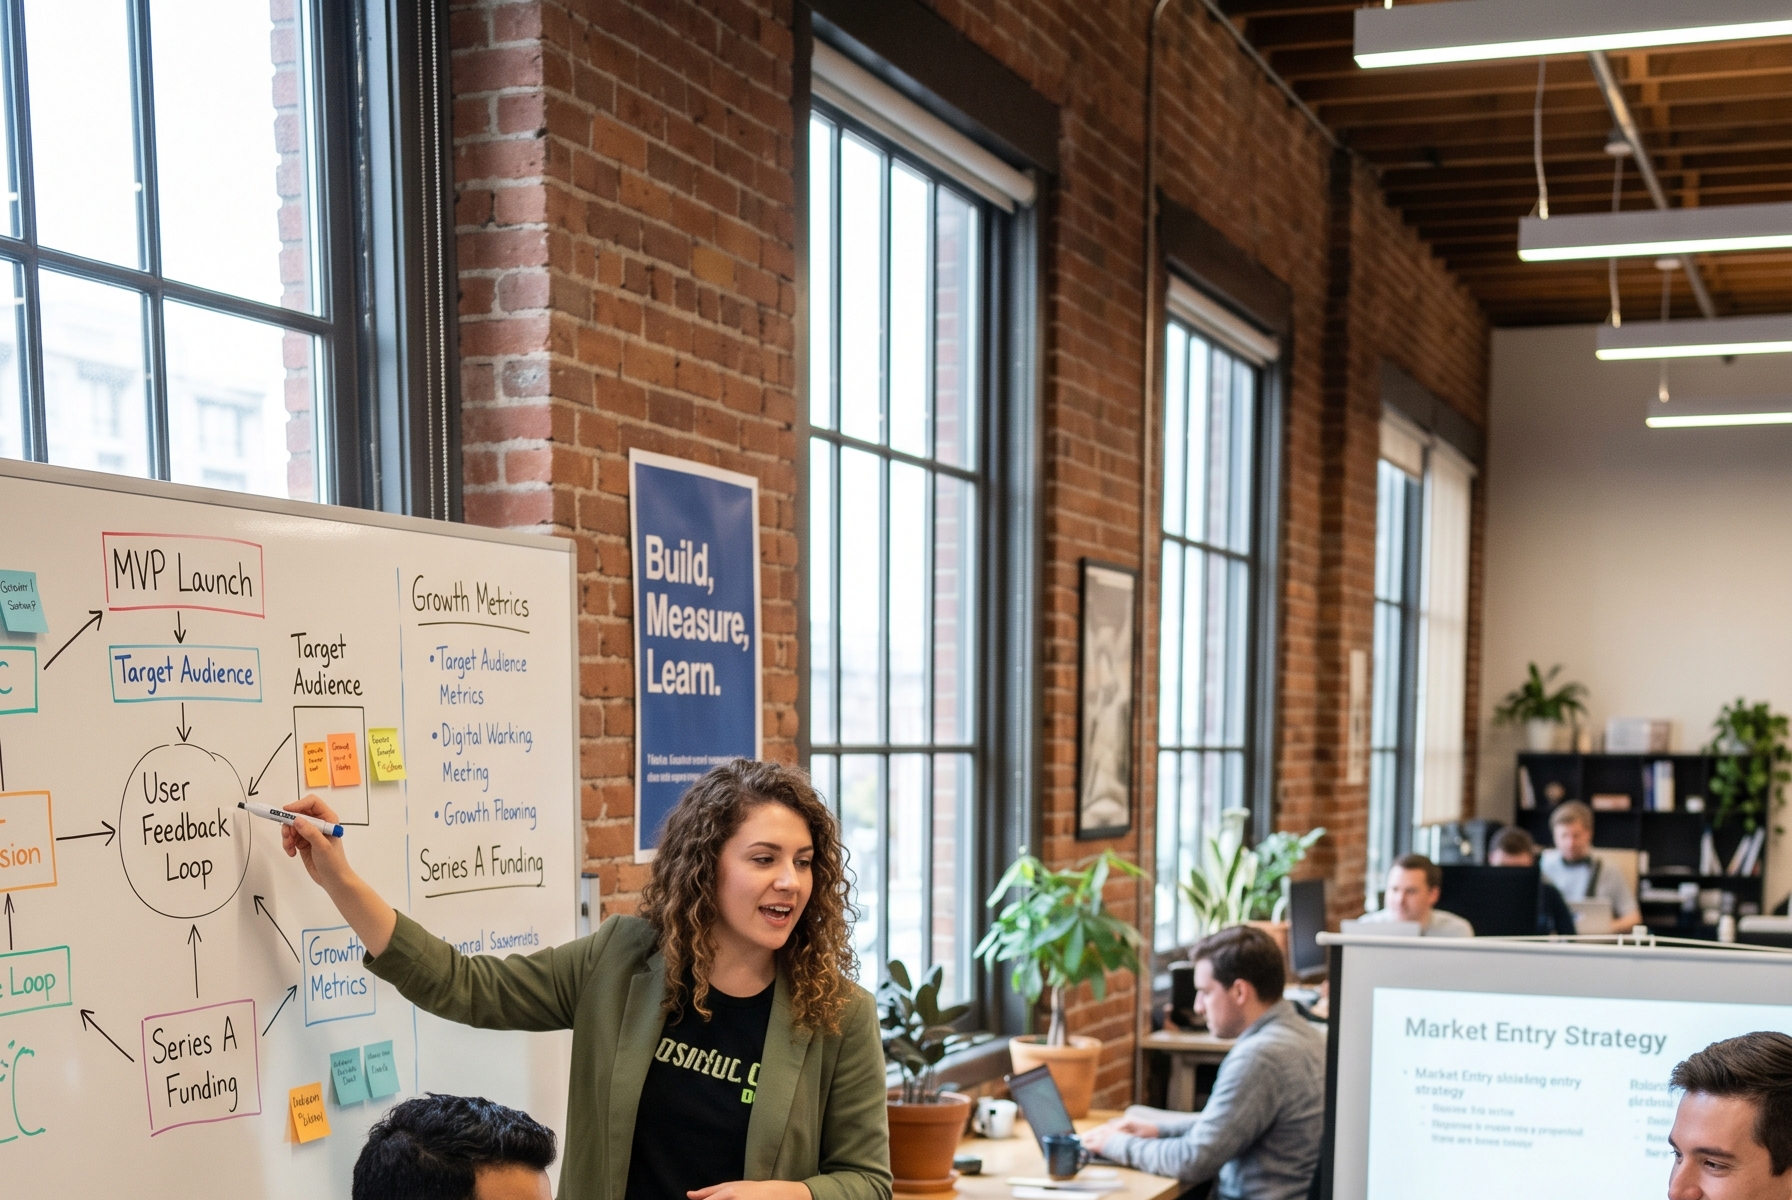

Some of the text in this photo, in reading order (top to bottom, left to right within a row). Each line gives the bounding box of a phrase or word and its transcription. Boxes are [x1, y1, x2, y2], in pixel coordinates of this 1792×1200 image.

[113, 548, 253, 597] MVP Launch
[645, 534, 714, 595] Build,
[412, 574, 530, 618] Growth Metrics
[646, 591, 750, 652] Measure,
[290, 632, 347, 668] Target
[436, 645, 528, 679] Target Audience
[114, 654, 254, 695] Target Audience
[293, 668, 363, 696] Audience
[646, 647, 722, 697] Learn.
[440, 684, 485, 706] Metrics
[442, 722, 533, 755] Digital Working
[142, 771, 190, 804] User
[142, 807, 230, 846] Feedback
[444, 801, 488, 826] Growth
[166, 853, 213, 890] Loop
[420, 845, 544, 887] Series A Funding
[309, 935, 364, 967] Growth
[10, 967, 56, 1001] Loop
[311, 972, 367, 1002] Metrics
[152, 1016, 238, 1065] Series A
[1405, 1017, 1668, 1055] Market Entry Strategy
[166, 1072, 238, 1113] Funding
